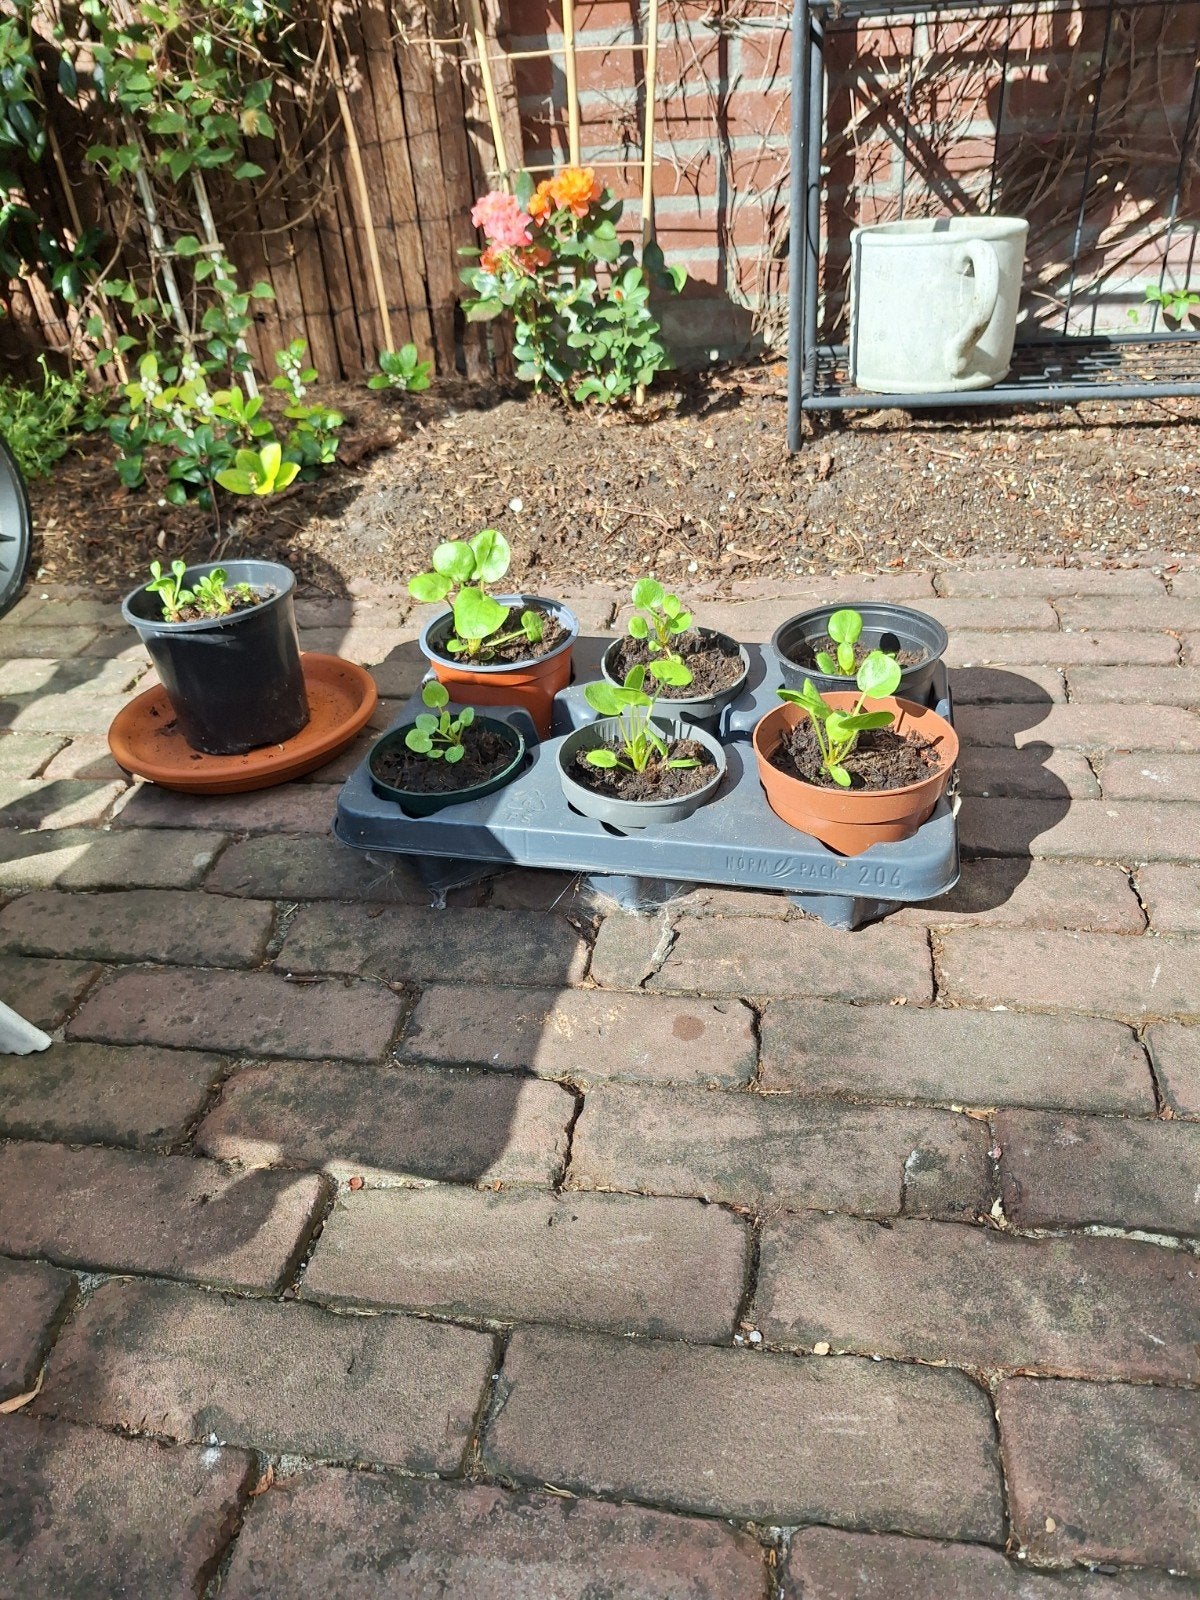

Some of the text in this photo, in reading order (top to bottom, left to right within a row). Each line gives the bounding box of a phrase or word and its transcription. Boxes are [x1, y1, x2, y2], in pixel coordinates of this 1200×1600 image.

[725, 856, 902, 888] NORM PACK 206
